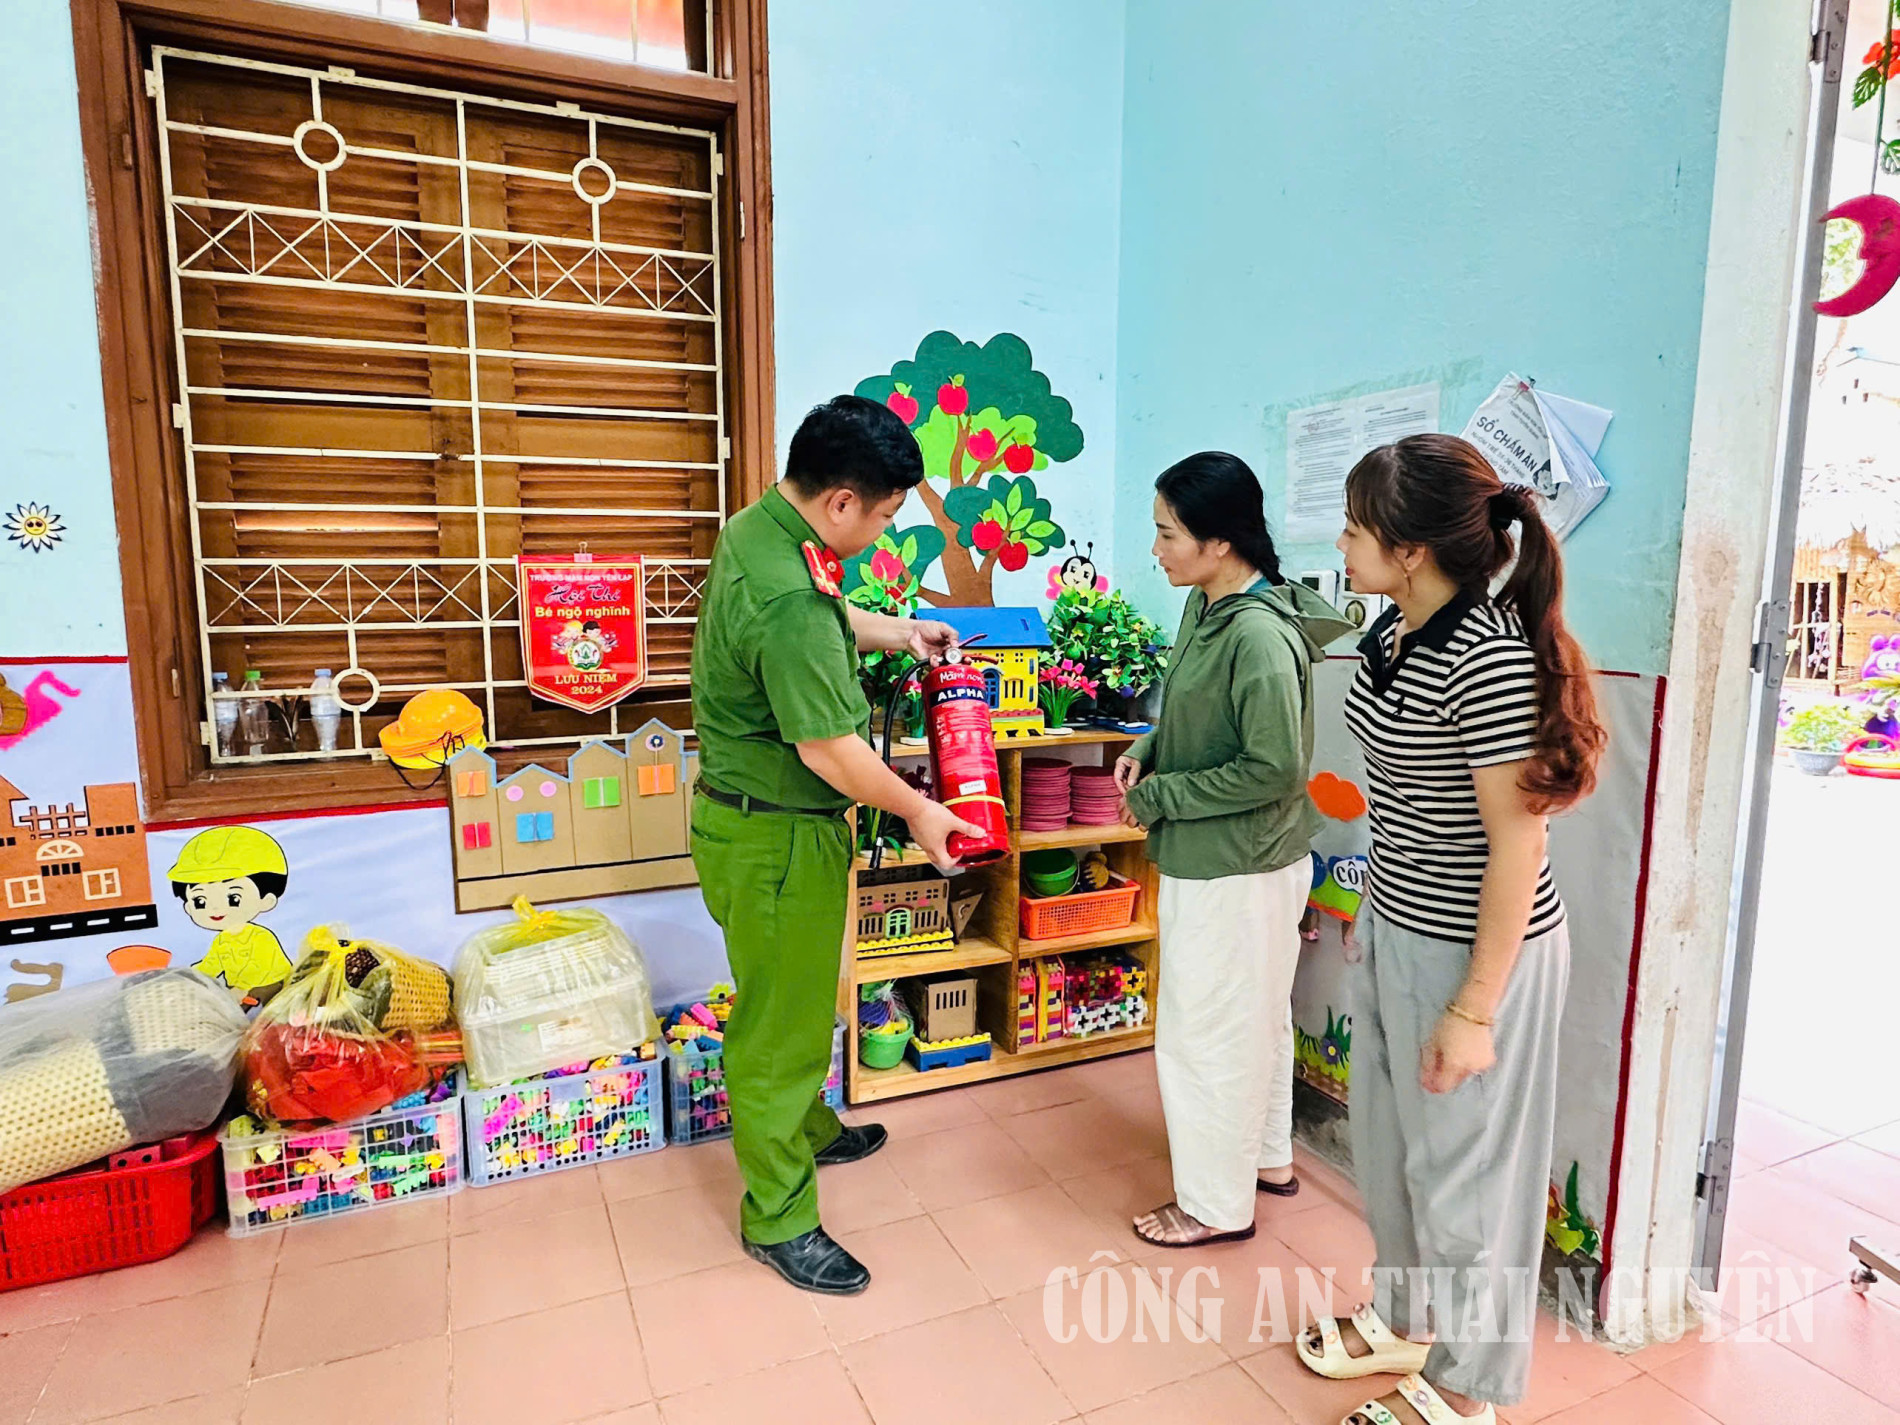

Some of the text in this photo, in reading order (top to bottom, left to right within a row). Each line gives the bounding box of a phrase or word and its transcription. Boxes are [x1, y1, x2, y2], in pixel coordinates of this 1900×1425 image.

[1477, 416, 1500, 433] SỔ
[544, 583, 621, 605] Hội Thi
[534, 606, 553, 618] Bé
[556, 606, 582, 620] ngộ
[555, 673, 617, 685] LƯU NIỆM
[571, 685, 603, 695] 2024
[937, 688, 984, 702] ALPHA
